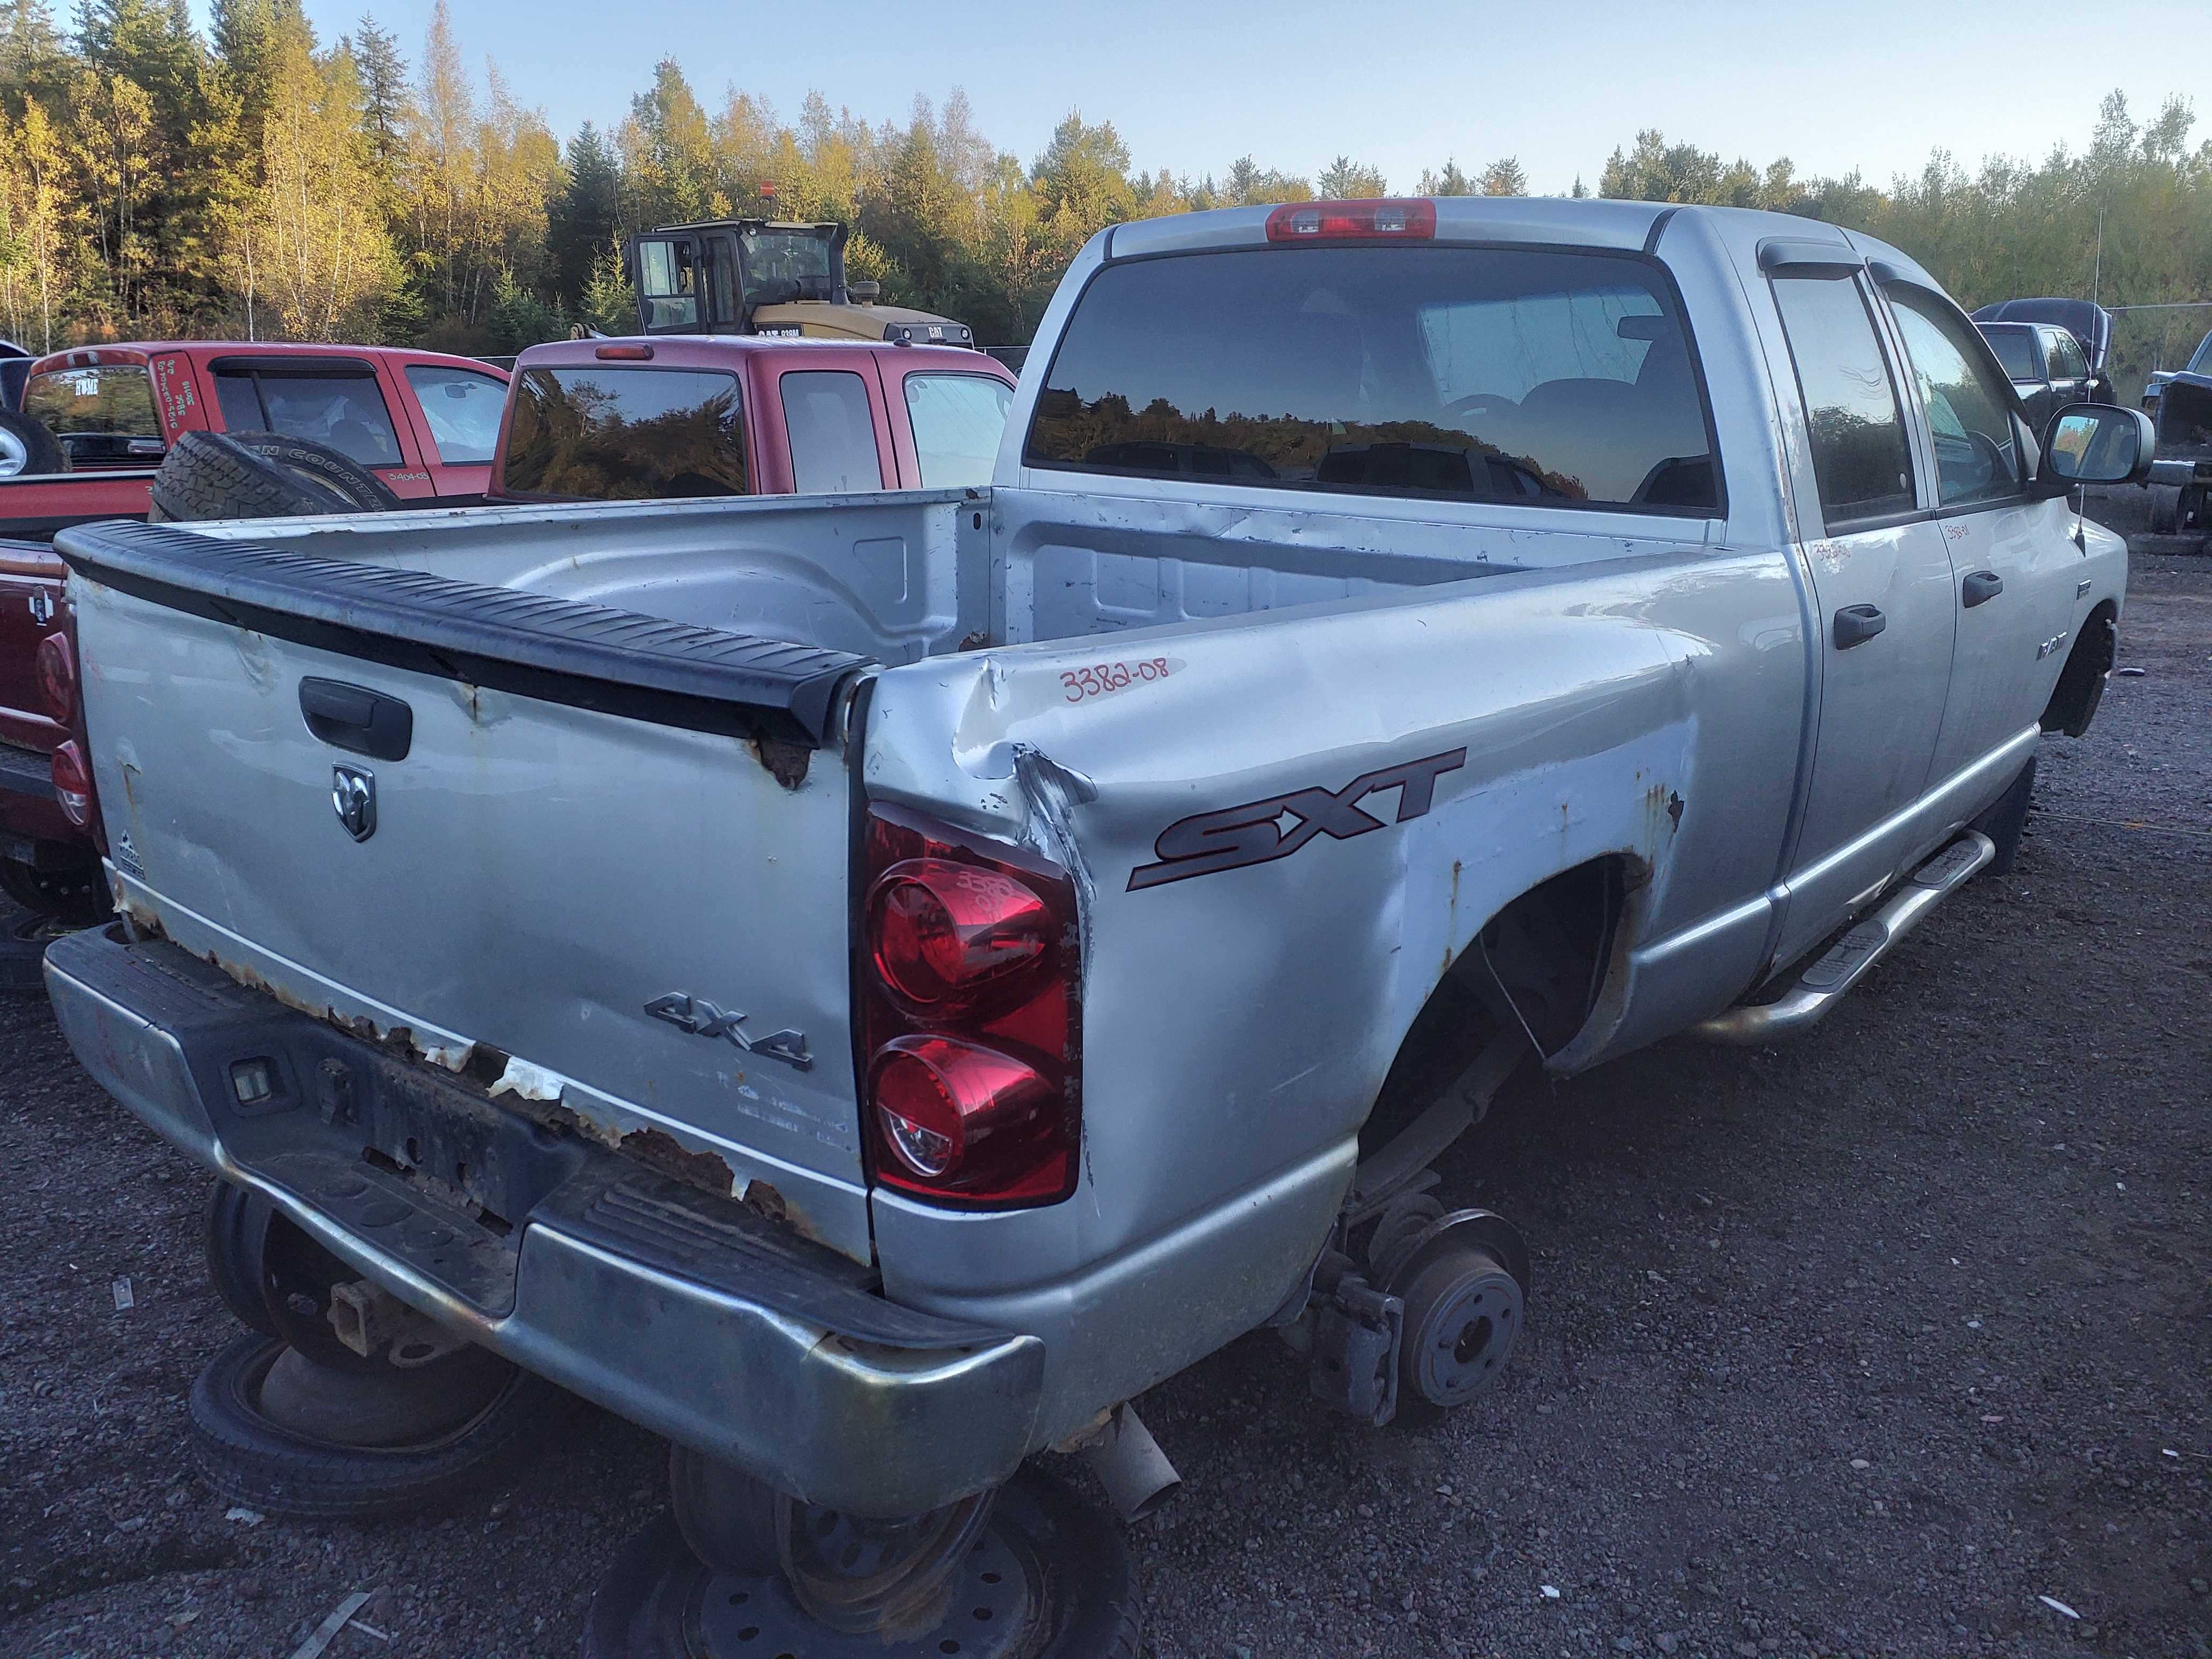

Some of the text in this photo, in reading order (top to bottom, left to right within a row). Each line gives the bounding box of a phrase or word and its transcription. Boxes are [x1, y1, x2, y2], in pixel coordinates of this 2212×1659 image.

[928, 326, 943, 338] CAT
[1059, 657, 1169, 703] 3382-08
[1125, 746, 1467, 892] SXT
